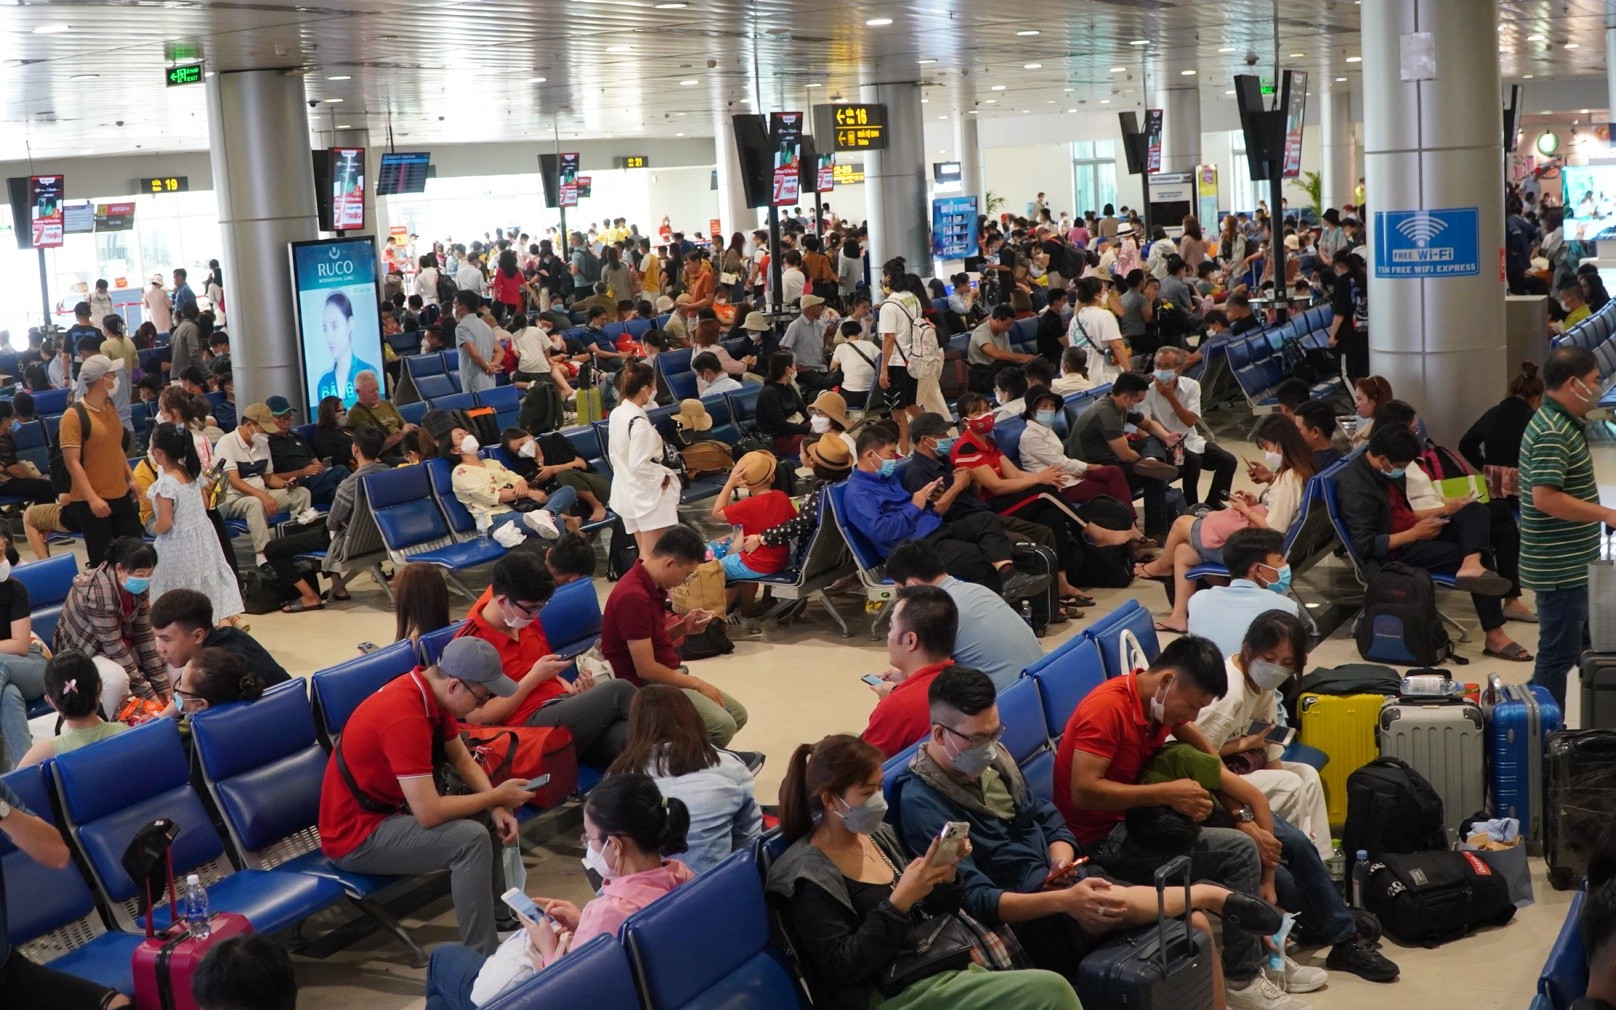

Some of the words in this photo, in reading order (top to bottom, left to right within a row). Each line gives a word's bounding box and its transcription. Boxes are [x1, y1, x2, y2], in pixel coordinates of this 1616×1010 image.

[856, 108, 867, 124] 16
[165, 179, 178, 190] 19
[774, 175, 784, 200] 7
[33, 224, 44, 246] 7
[1393, 252, 1413, 260] FREE
[1418, 248, 1452, 260] Wi-Fi
[318, 260, 354, 276] RUCO
[1377, 266, 1390, 274] TSN
[1391, 265, 1412, 273] FREE
[1414, 265, 1434, 273] WIFI
[1436, 263, 1476, 272] EXPRESS
